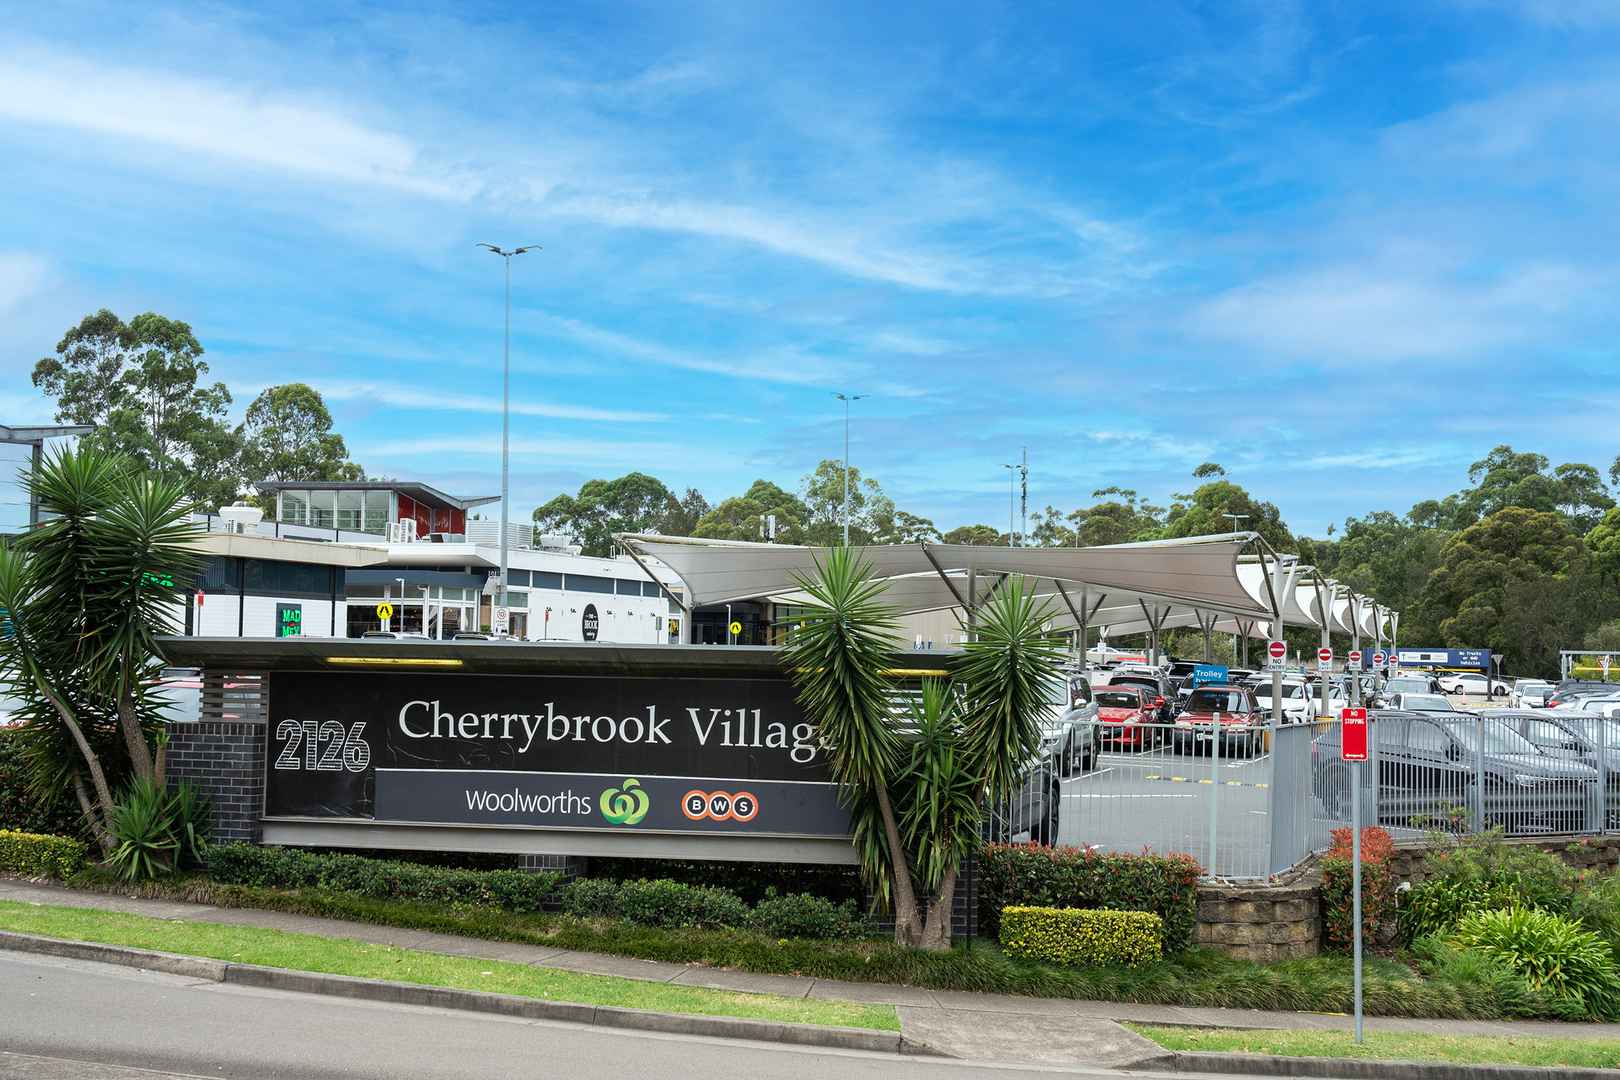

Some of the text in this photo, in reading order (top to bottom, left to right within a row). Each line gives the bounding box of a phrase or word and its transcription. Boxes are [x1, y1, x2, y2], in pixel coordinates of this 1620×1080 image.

[282, 609, 301, 622] MAD
[1196, 670, 1223, 678] Trolley
[398, 700, 672, 754] Cherrybrook
[274, 719, 370, 772] 2126
[465, 787, 592, 815] Woolworths
